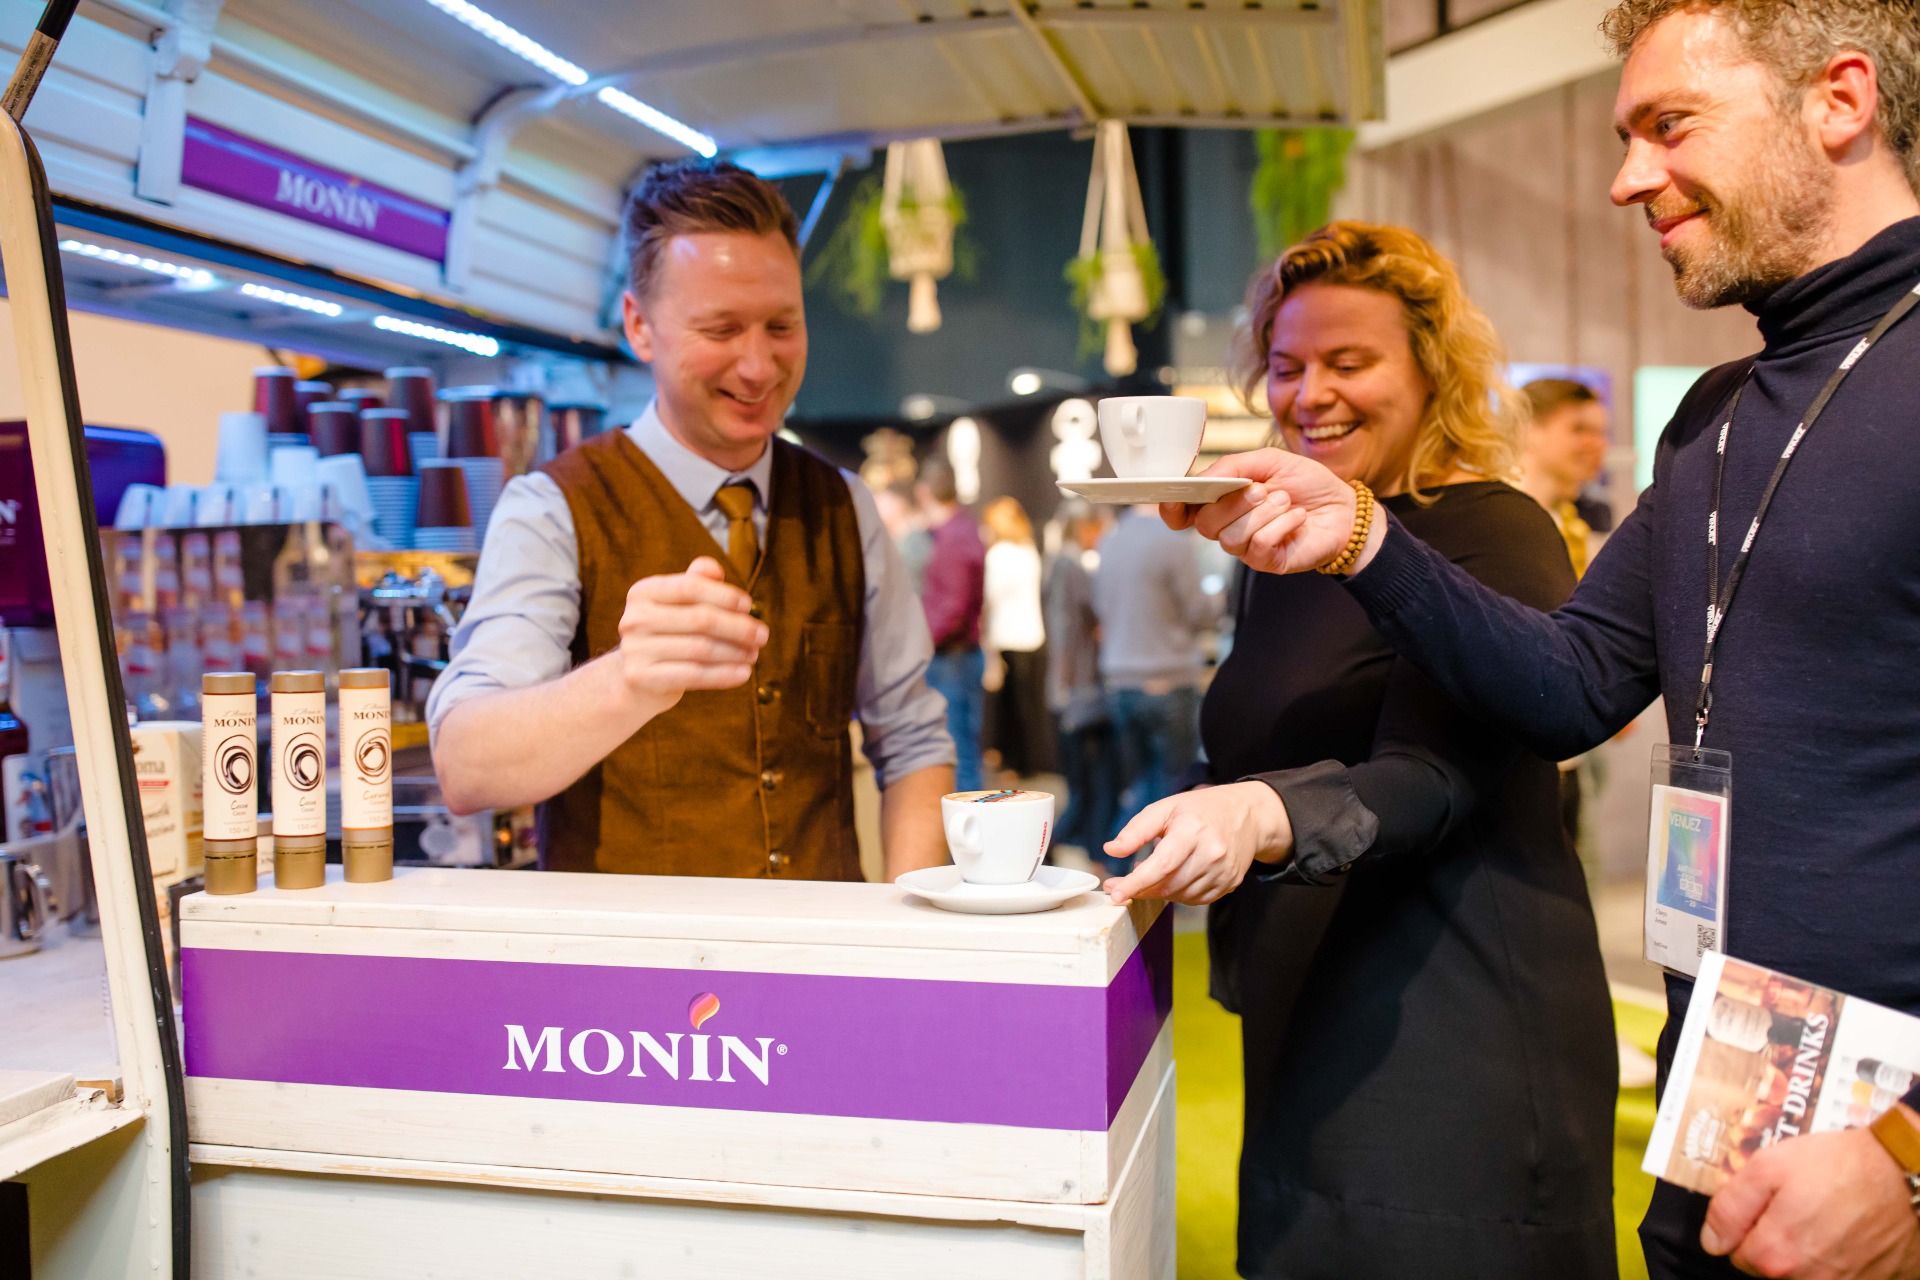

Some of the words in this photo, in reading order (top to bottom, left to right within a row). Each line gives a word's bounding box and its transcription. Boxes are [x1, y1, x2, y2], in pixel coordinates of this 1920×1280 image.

[275, 169, 379, 231] MONIN
[1671, 814, 1702, 833] VENUEZ
[1782, 1012, 1830, 1117] DRINKS
